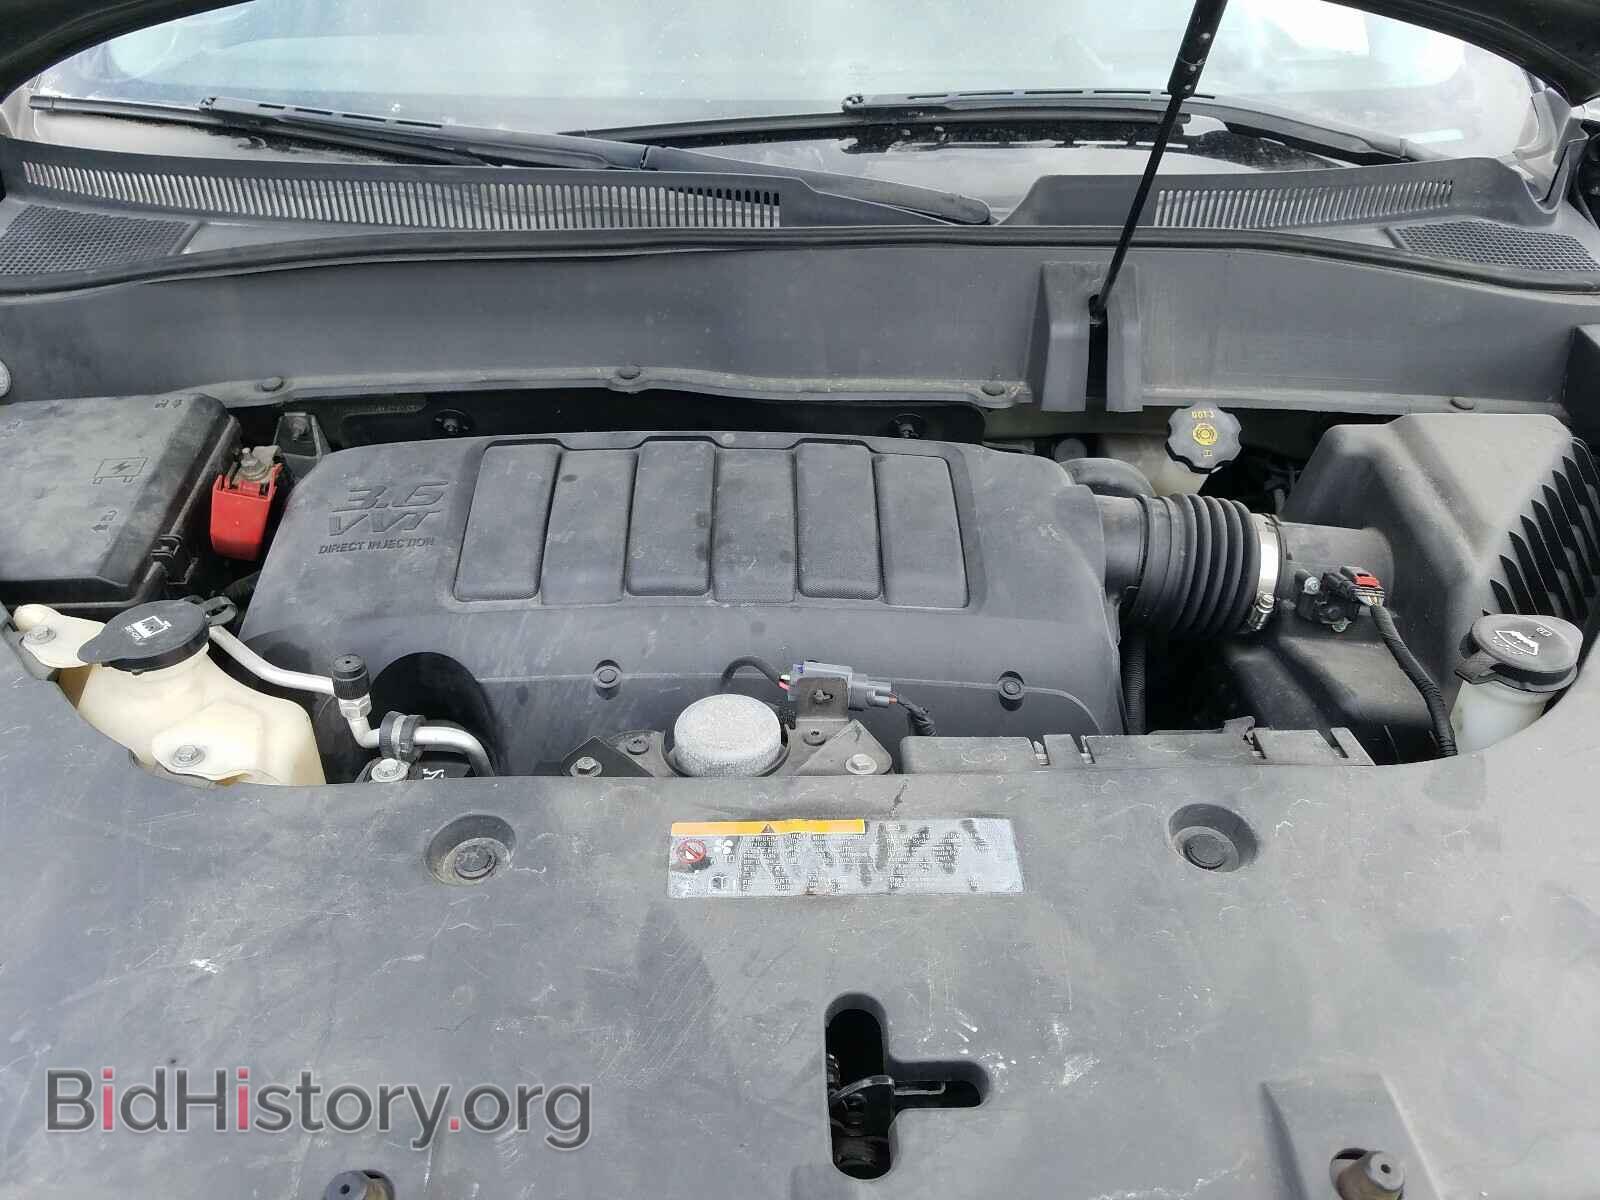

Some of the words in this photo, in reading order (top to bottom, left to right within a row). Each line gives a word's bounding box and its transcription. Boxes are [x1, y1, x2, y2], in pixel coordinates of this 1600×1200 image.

[332, 480, 449, 513] 3.6
[328, 510, 441, 537] VVT
[318, 541, 364, 554] DIRECT
[367, 536, 434, 551] INJECTION
